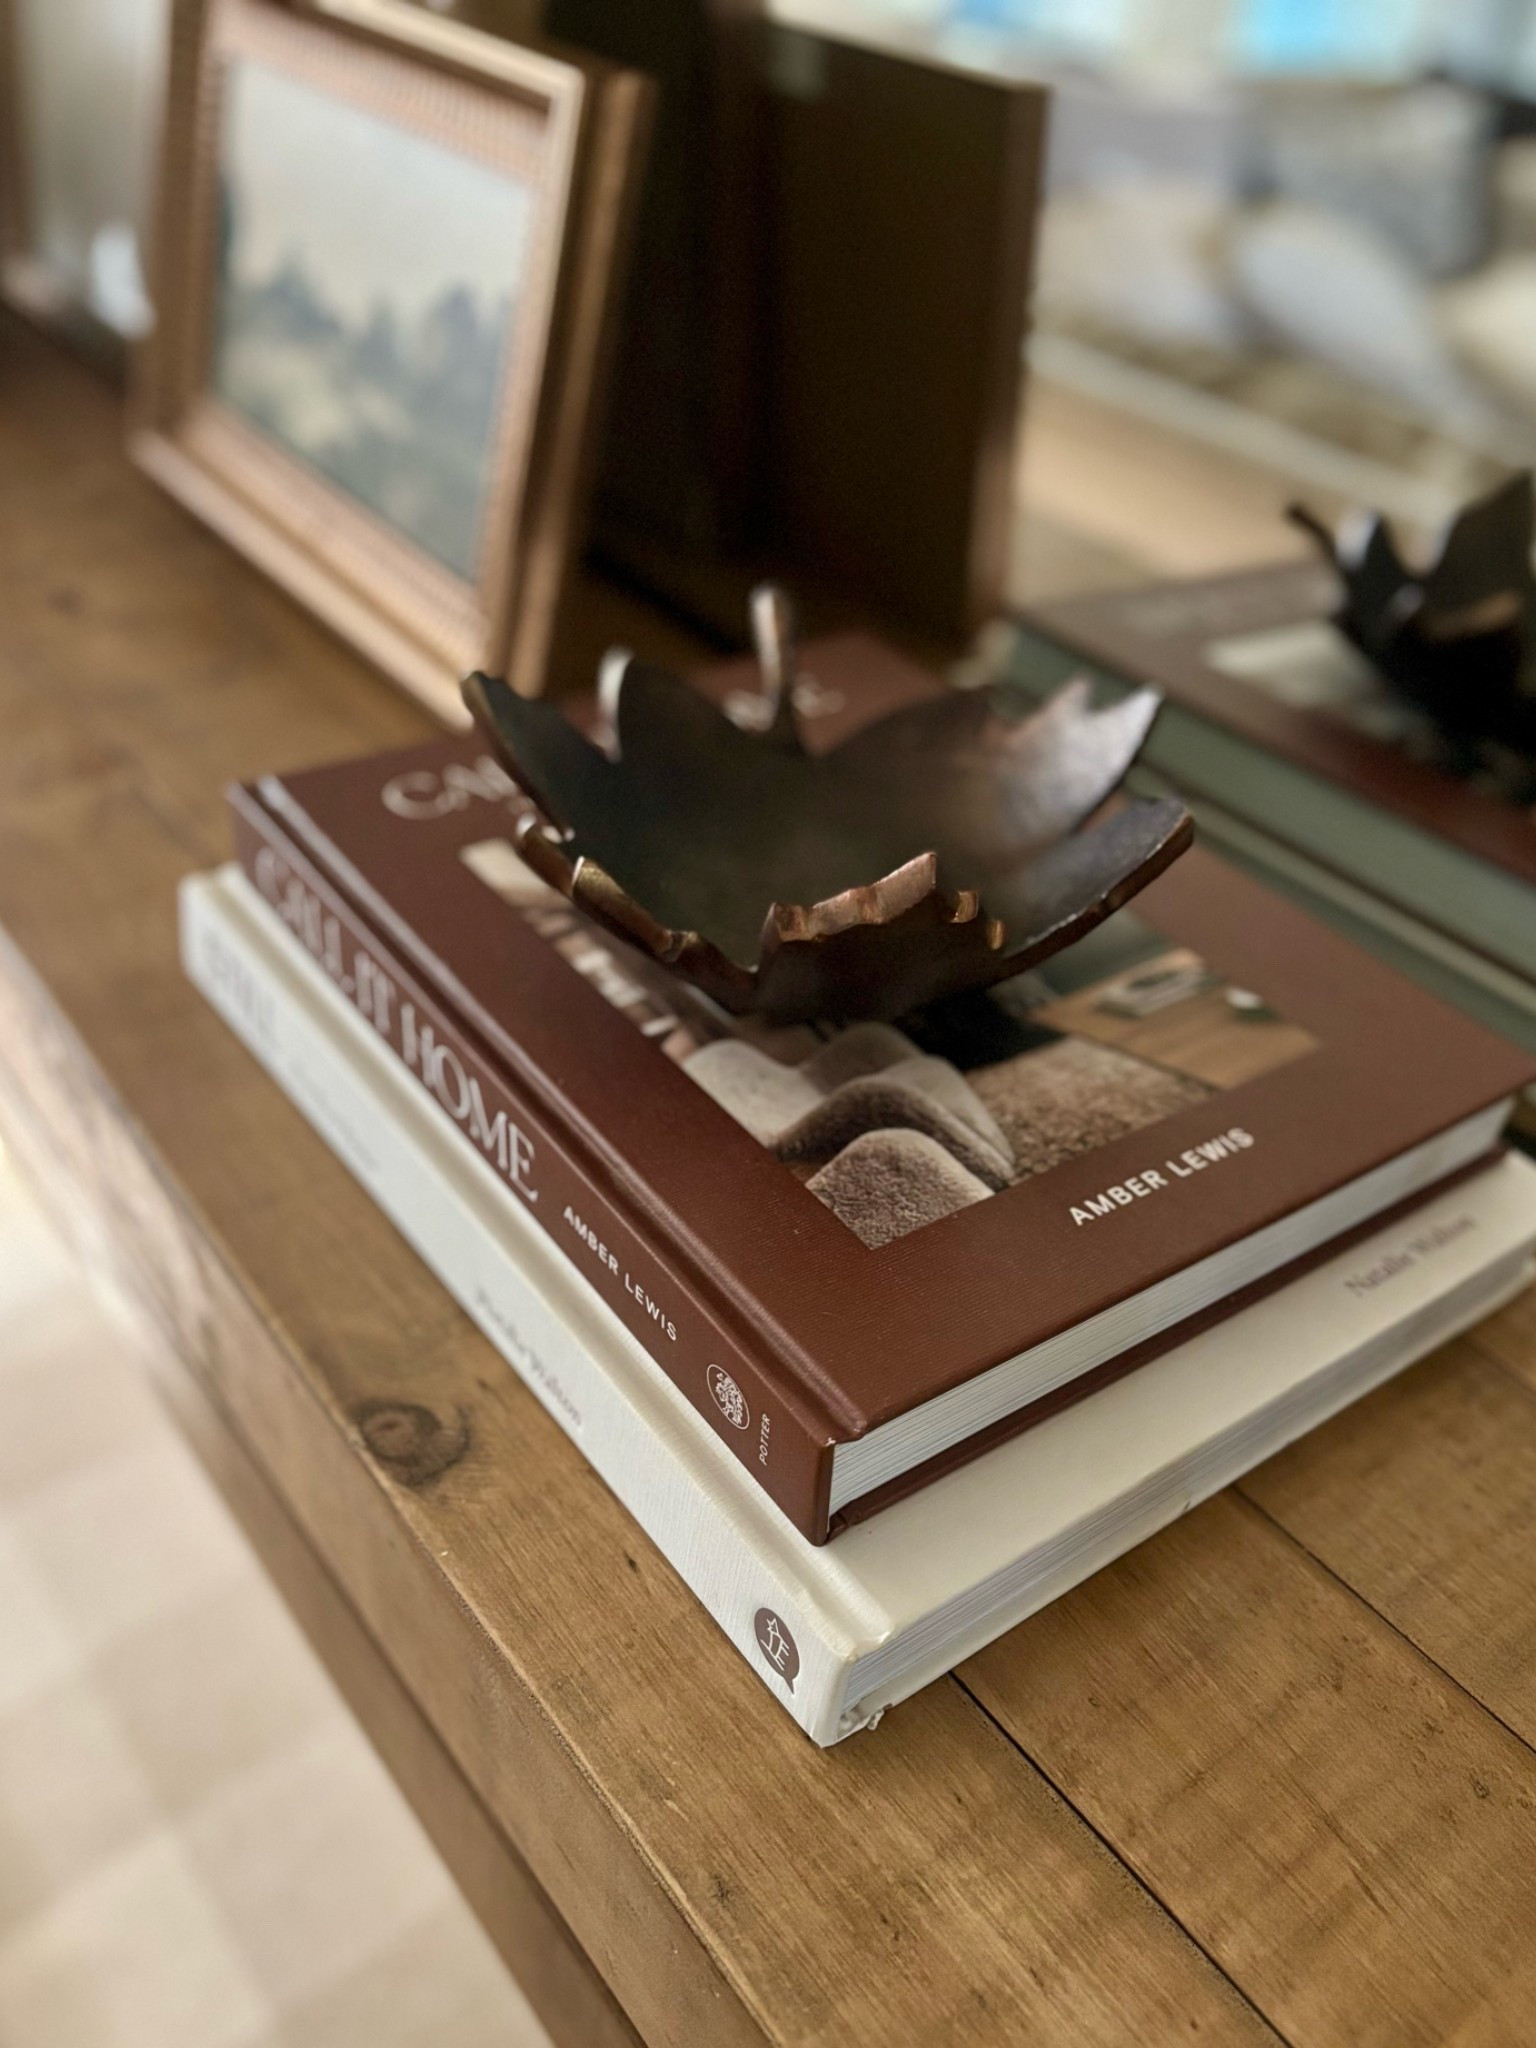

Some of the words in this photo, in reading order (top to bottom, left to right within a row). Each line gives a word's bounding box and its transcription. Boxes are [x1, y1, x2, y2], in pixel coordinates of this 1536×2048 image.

[355, 953, 396, 1034] IT
[400, 1002, 538, 1200] HOME
[1069, 1169, 1168, 1226] AMBER
[1165, 1127, 1254, 1177] LEWIS
[563, 1206, 618, 1275] AMBER
[624, 1272, 677, 1341] LEWIS
[759, 1413, 770, 1466] POTTER
